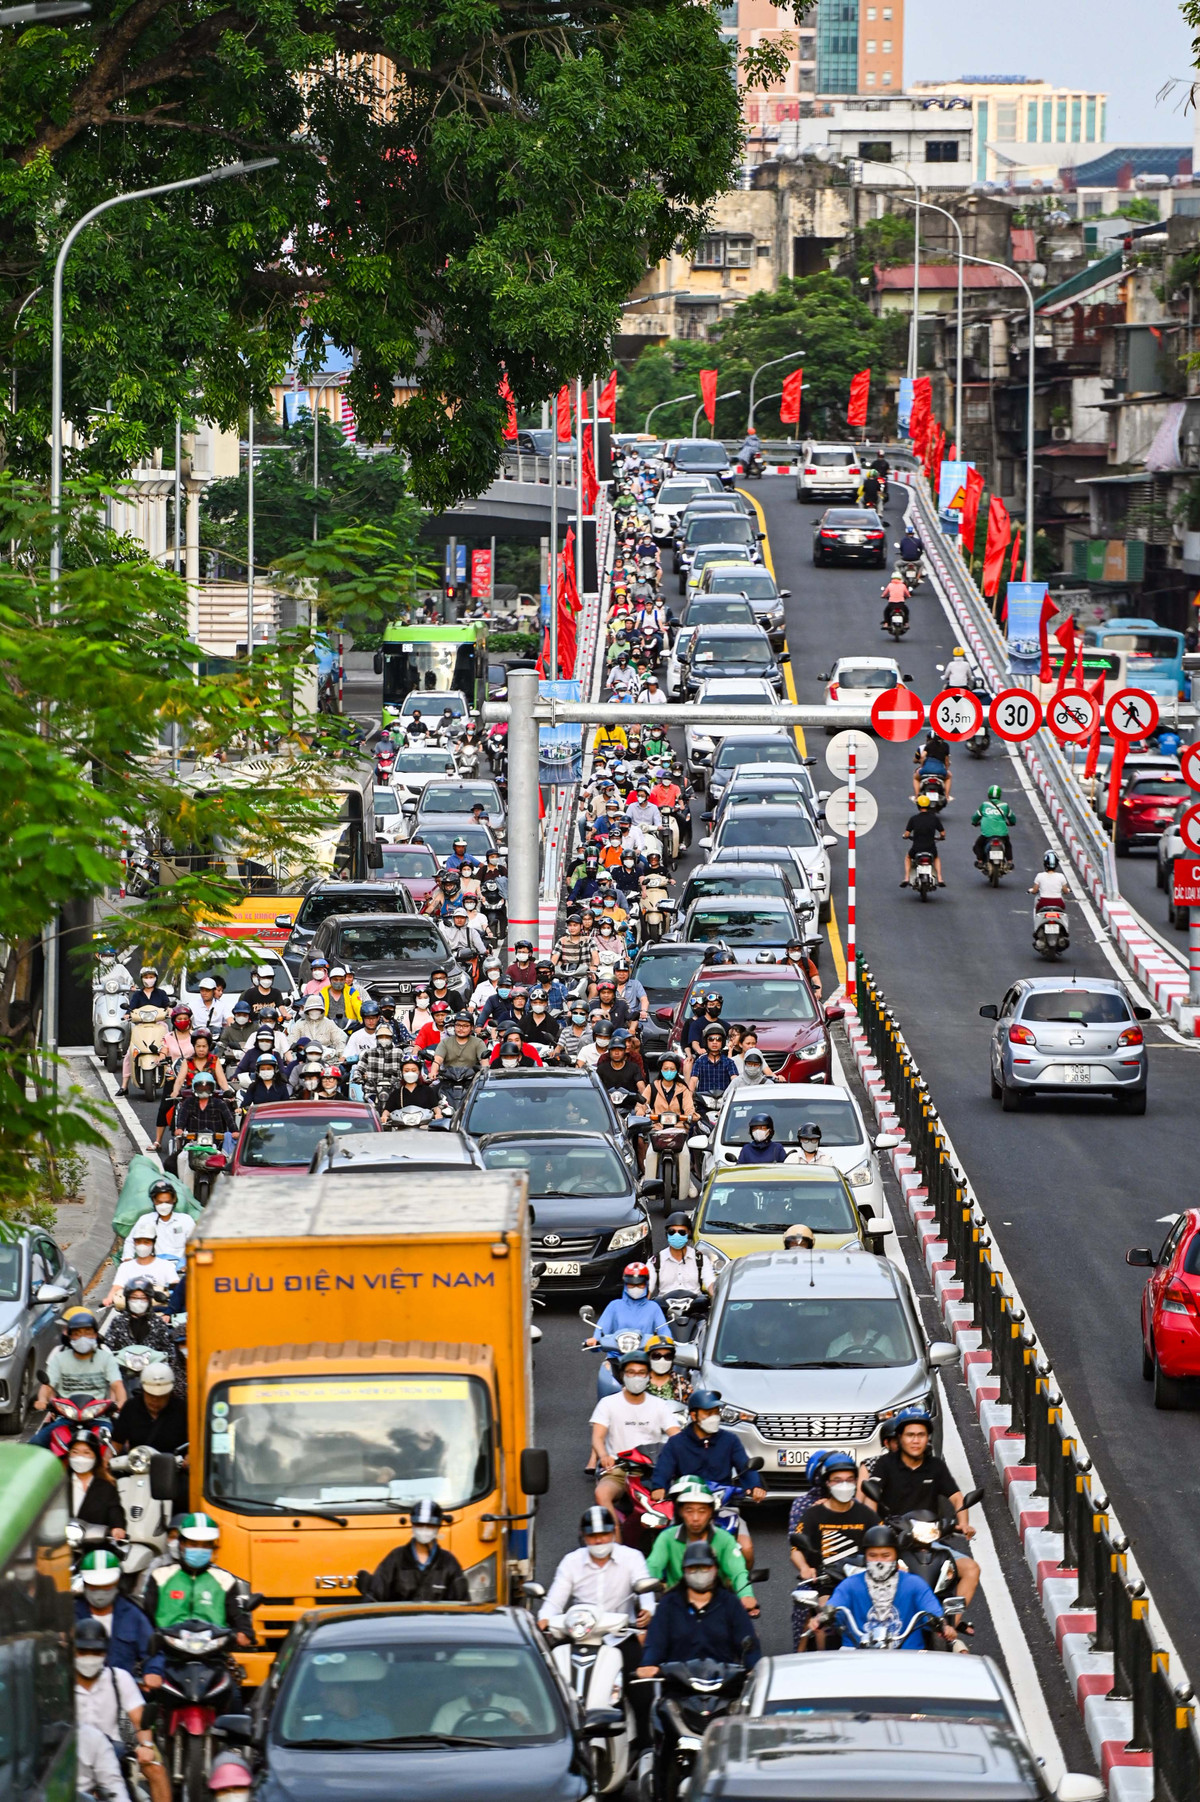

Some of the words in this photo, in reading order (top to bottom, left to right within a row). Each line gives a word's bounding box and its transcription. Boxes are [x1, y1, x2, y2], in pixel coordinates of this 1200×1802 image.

[941, 706, 971, 725] 3,5m
[1004, 704, 1028, 726] 30
[985, 807, 1004, 816] Gra
[214, 1272, 273, 1293] BƯU
[284, 1268, 354, 1297] ĐIỆN
[363, 1266, 424, 1295] VIỆT
[432, 1271, 495, 1288] NAM
